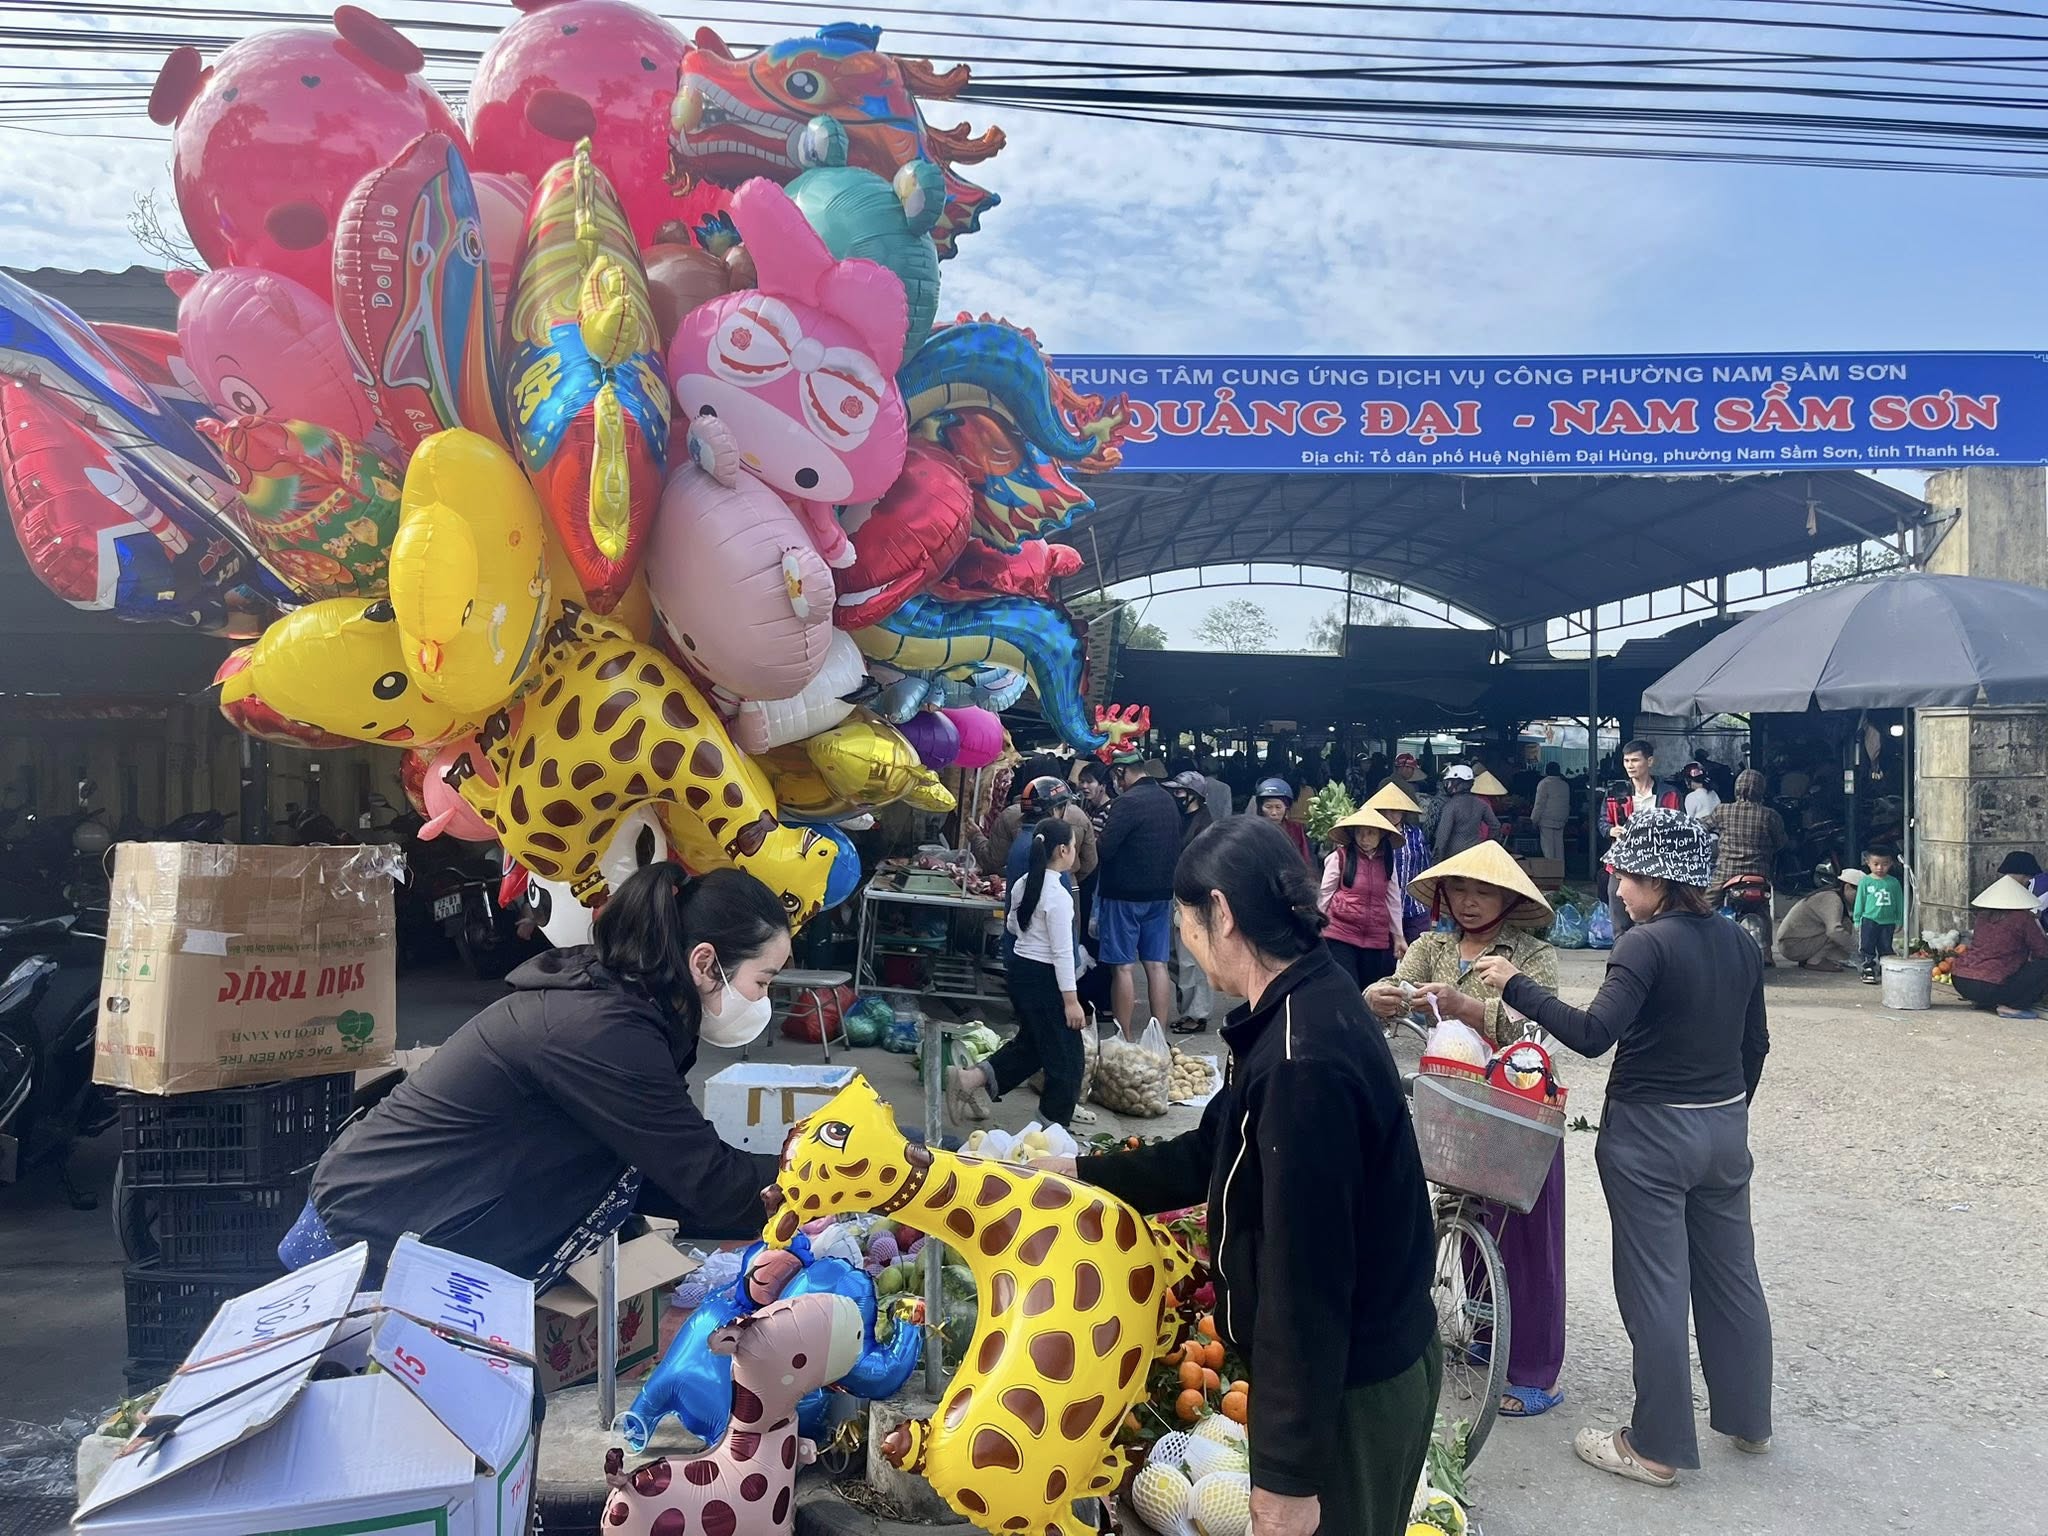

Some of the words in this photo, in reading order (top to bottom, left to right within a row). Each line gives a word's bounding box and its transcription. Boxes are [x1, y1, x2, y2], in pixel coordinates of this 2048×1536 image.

[1054, 368, 1149, 385] TRUNG
[1156, 364, 1213, 385] TÂM
[1221, 368, 1300, 386] CUNG
[1308, 365, 1369, 386] ỨNG
[1377, 369, 1442, 389] DỊCH
[1449, 369, 1486, 390] VỤ
[1493, 365, 1574, 386] CÔNG
[1582, 363, 1704, 385] PHƯỜNG
[1712, 366, 1773, 383] NAM
[1847, 363, 1907, 381] SƠN
[1112, 387, 1346, 443] QUẢNG
[1361, 399, 1482, 445] ĐẠI
[1513, 414, 1535, 428] -
[1548, 398, 1699, 436] NAM
[1714, 381, 1855, 433] SẦM
[1869, 388, 2000, 432] SƠN
[1301, 450, 1329, 465] Địa
[1334, 449, 1364, 464] chỉ:
[1396, 448, 1427, 464] dân
[1432, 447, 1465, 467] phố
[1469, 450, 1502, 466] Huệ
[1507, 448, 1570, 466] Nghiêm
[1576, 448, 1604, 464] Đại
[1608, 447, 1658, 466] Hùng,
[1737, 447, 1775, 460] Nam
[1823, 445, 1863, 461] Sơn,
[1867, 444, 1900, 459] tỉnh
[1904, 444, 1958, 458] Thanh
[1962, 443, 2000, 458] Hóa.
[217, 965, 307, 1006] TRỰC
[316, 962, 366, 999] SÁU
